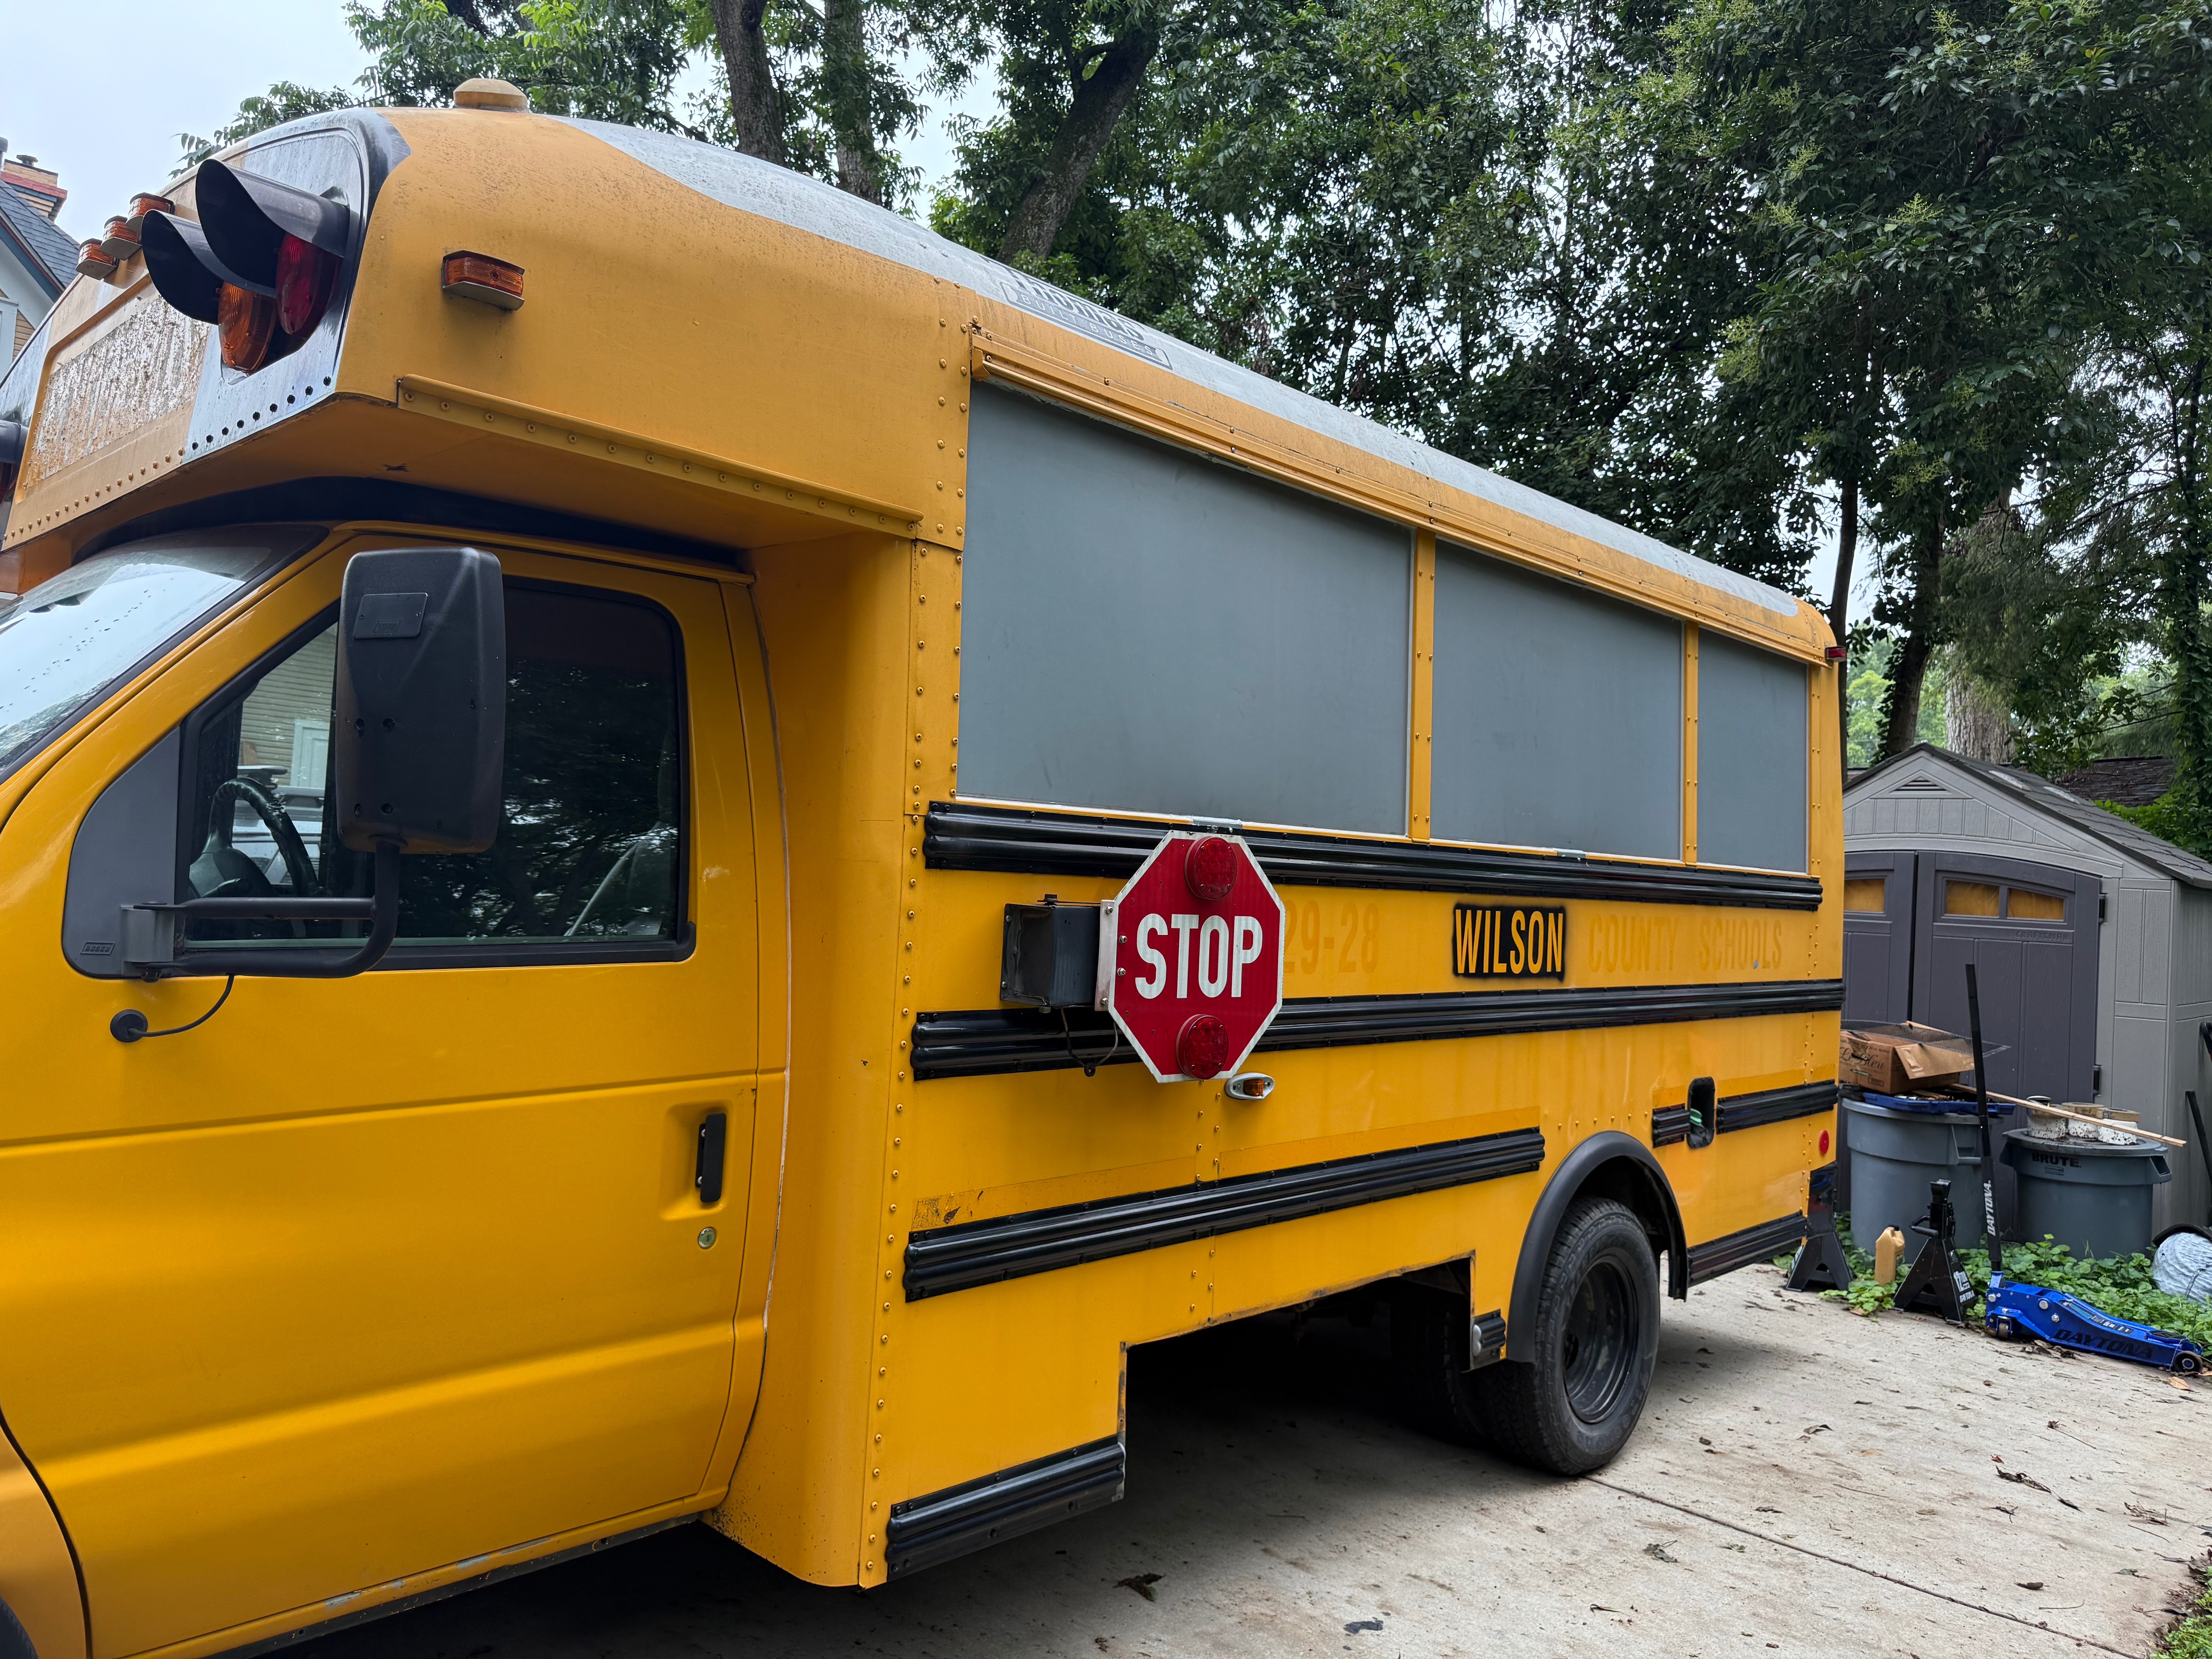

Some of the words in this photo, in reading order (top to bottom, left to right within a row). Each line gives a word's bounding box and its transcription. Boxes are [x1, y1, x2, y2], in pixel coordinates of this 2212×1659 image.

[1020, 294, 1077, 324] BUILT
[1089, 322, 1153, 356] BUSES
[1135, 913, 1264, 1000] STOP
[1455, 909, 1564, 974] WILSON
[1589, 913, 1679, 973] COUNTY
[1698, 918, 1782, 970] SCHOOLS
[2015, 931, 2069, 941] CRAFTSMAN
[2032, 1152, 2080, 1168] BRUTE
[1984, 1180, 1996, 1236] DAYTONA
[2053, 1329, 2154, 1358] DAYTONA
